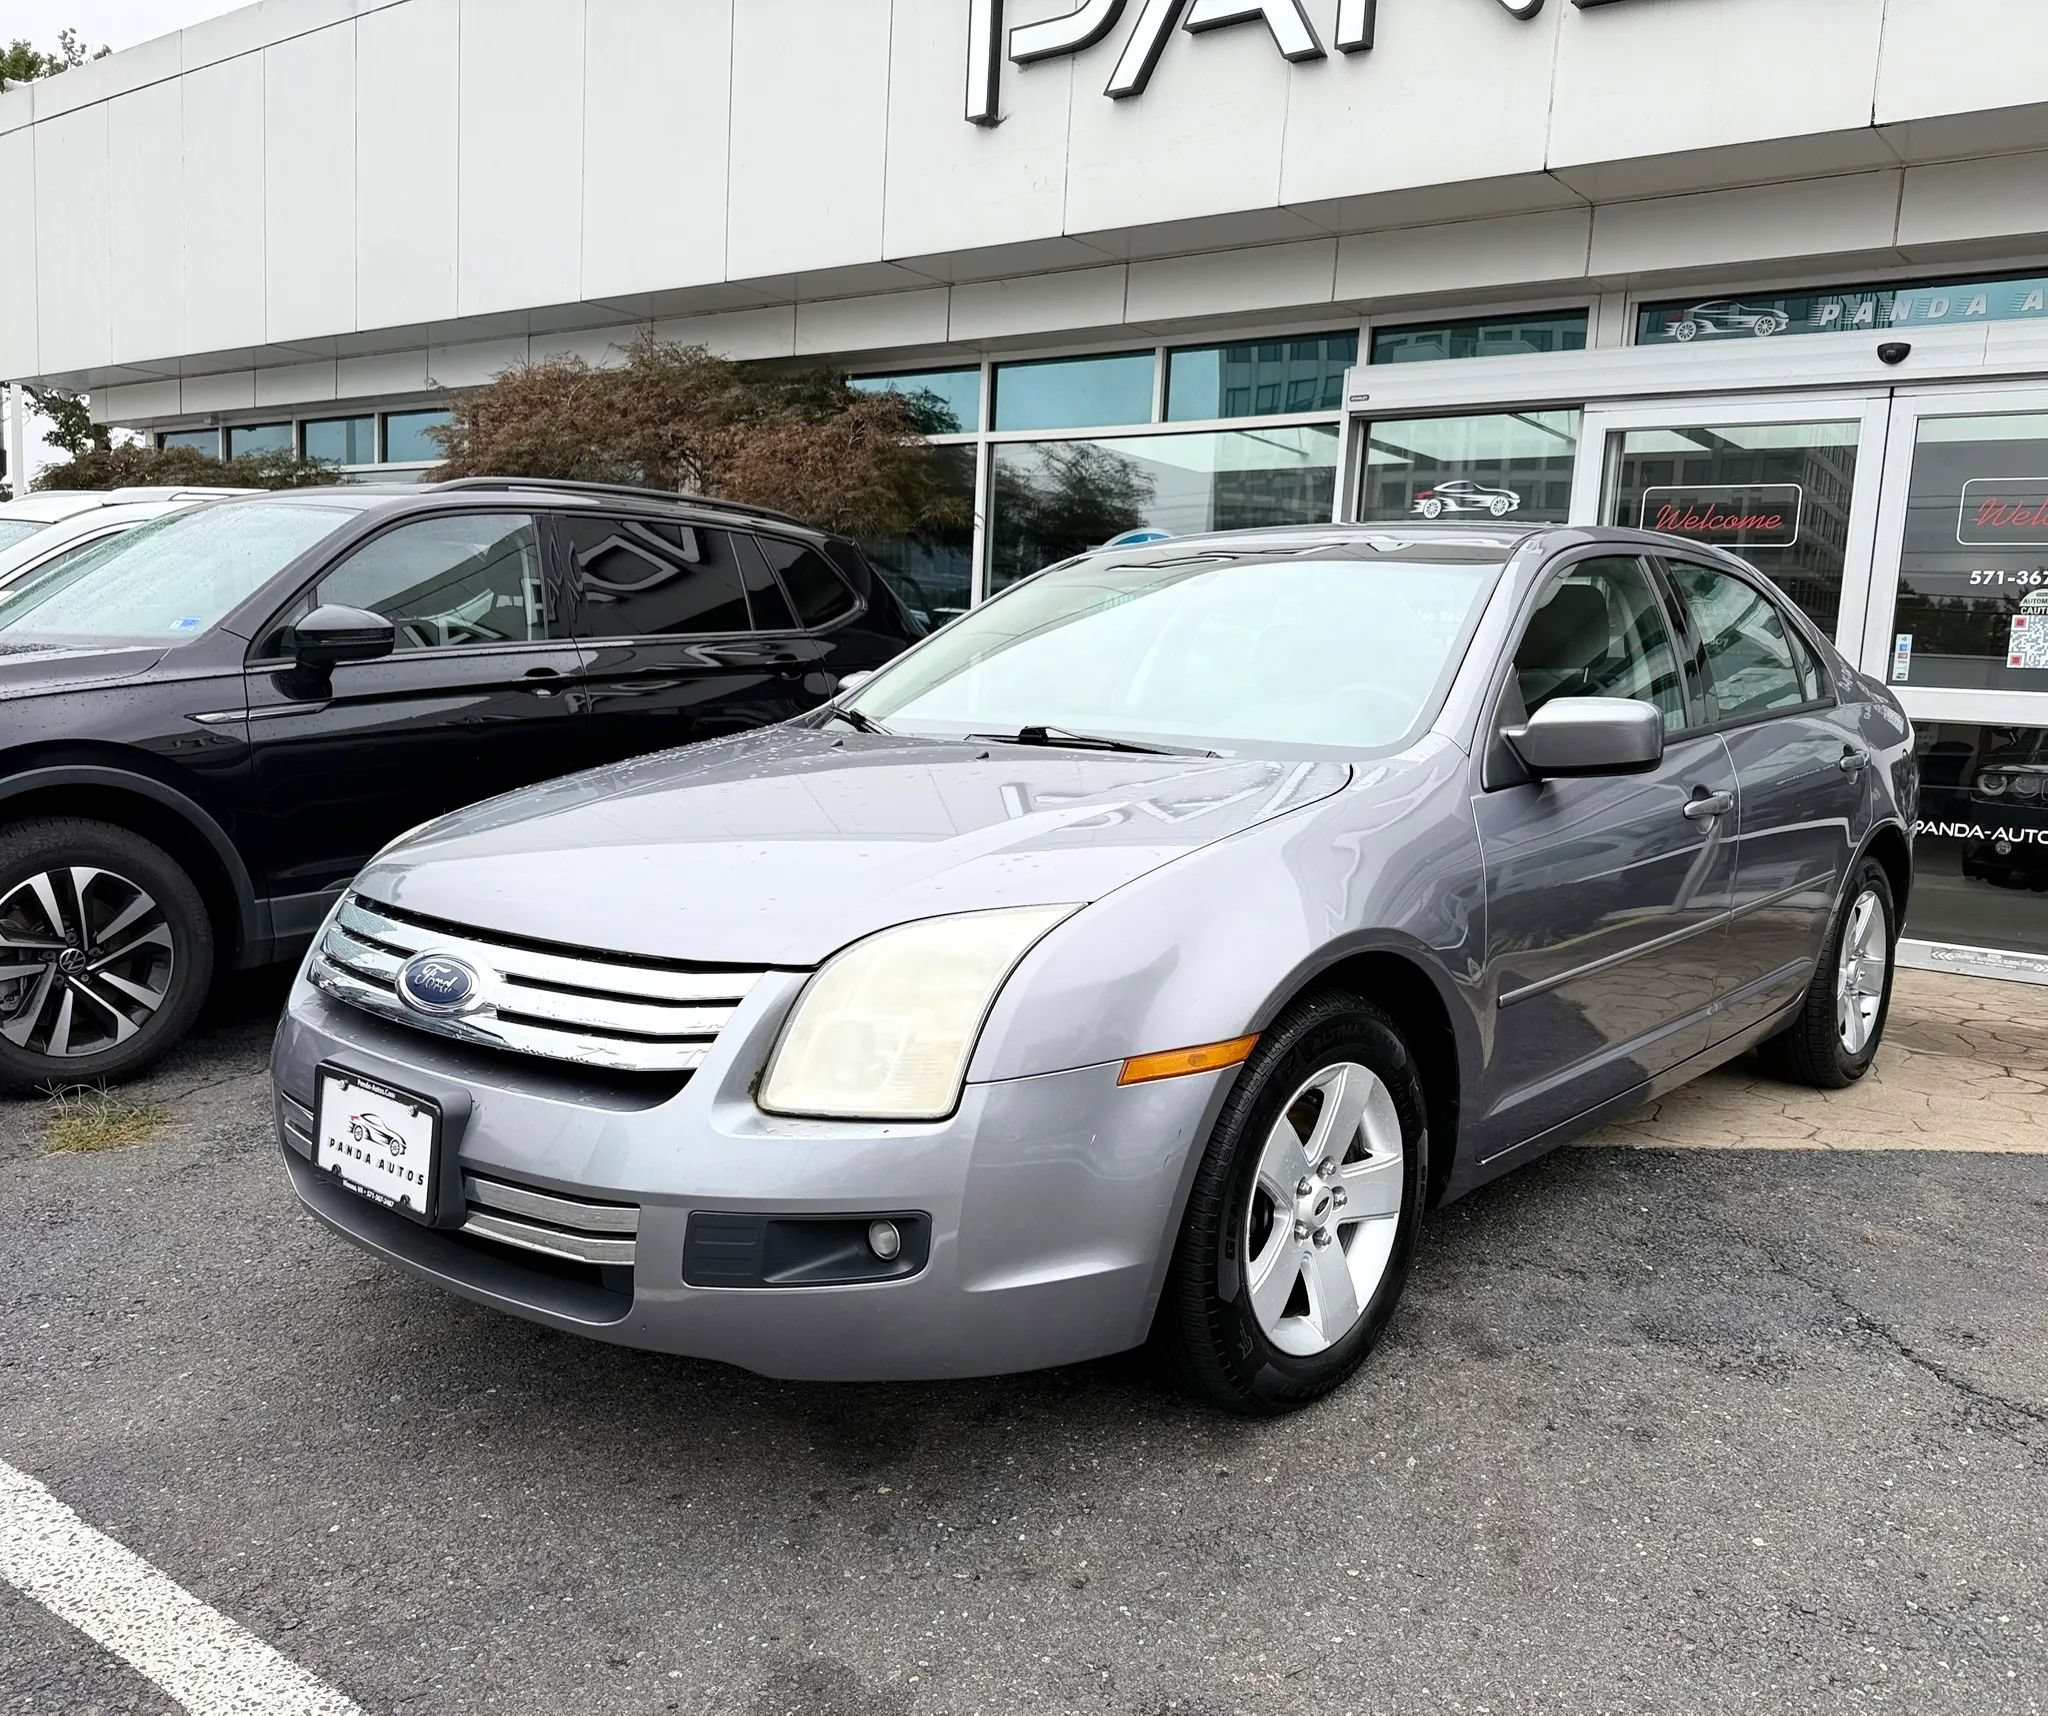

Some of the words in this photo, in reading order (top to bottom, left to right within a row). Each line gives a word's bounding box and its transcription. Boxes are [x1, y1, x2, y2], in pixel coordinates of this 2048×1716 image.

[1808, 292, 1988, 327] PANDA
[1655, 503, 1783, 530] Welcome
[414, 963, 459, 994] Ford
[329, 1137, 371, 1165] PANDA
[378, 1159, 424, 1186] AUTOS
